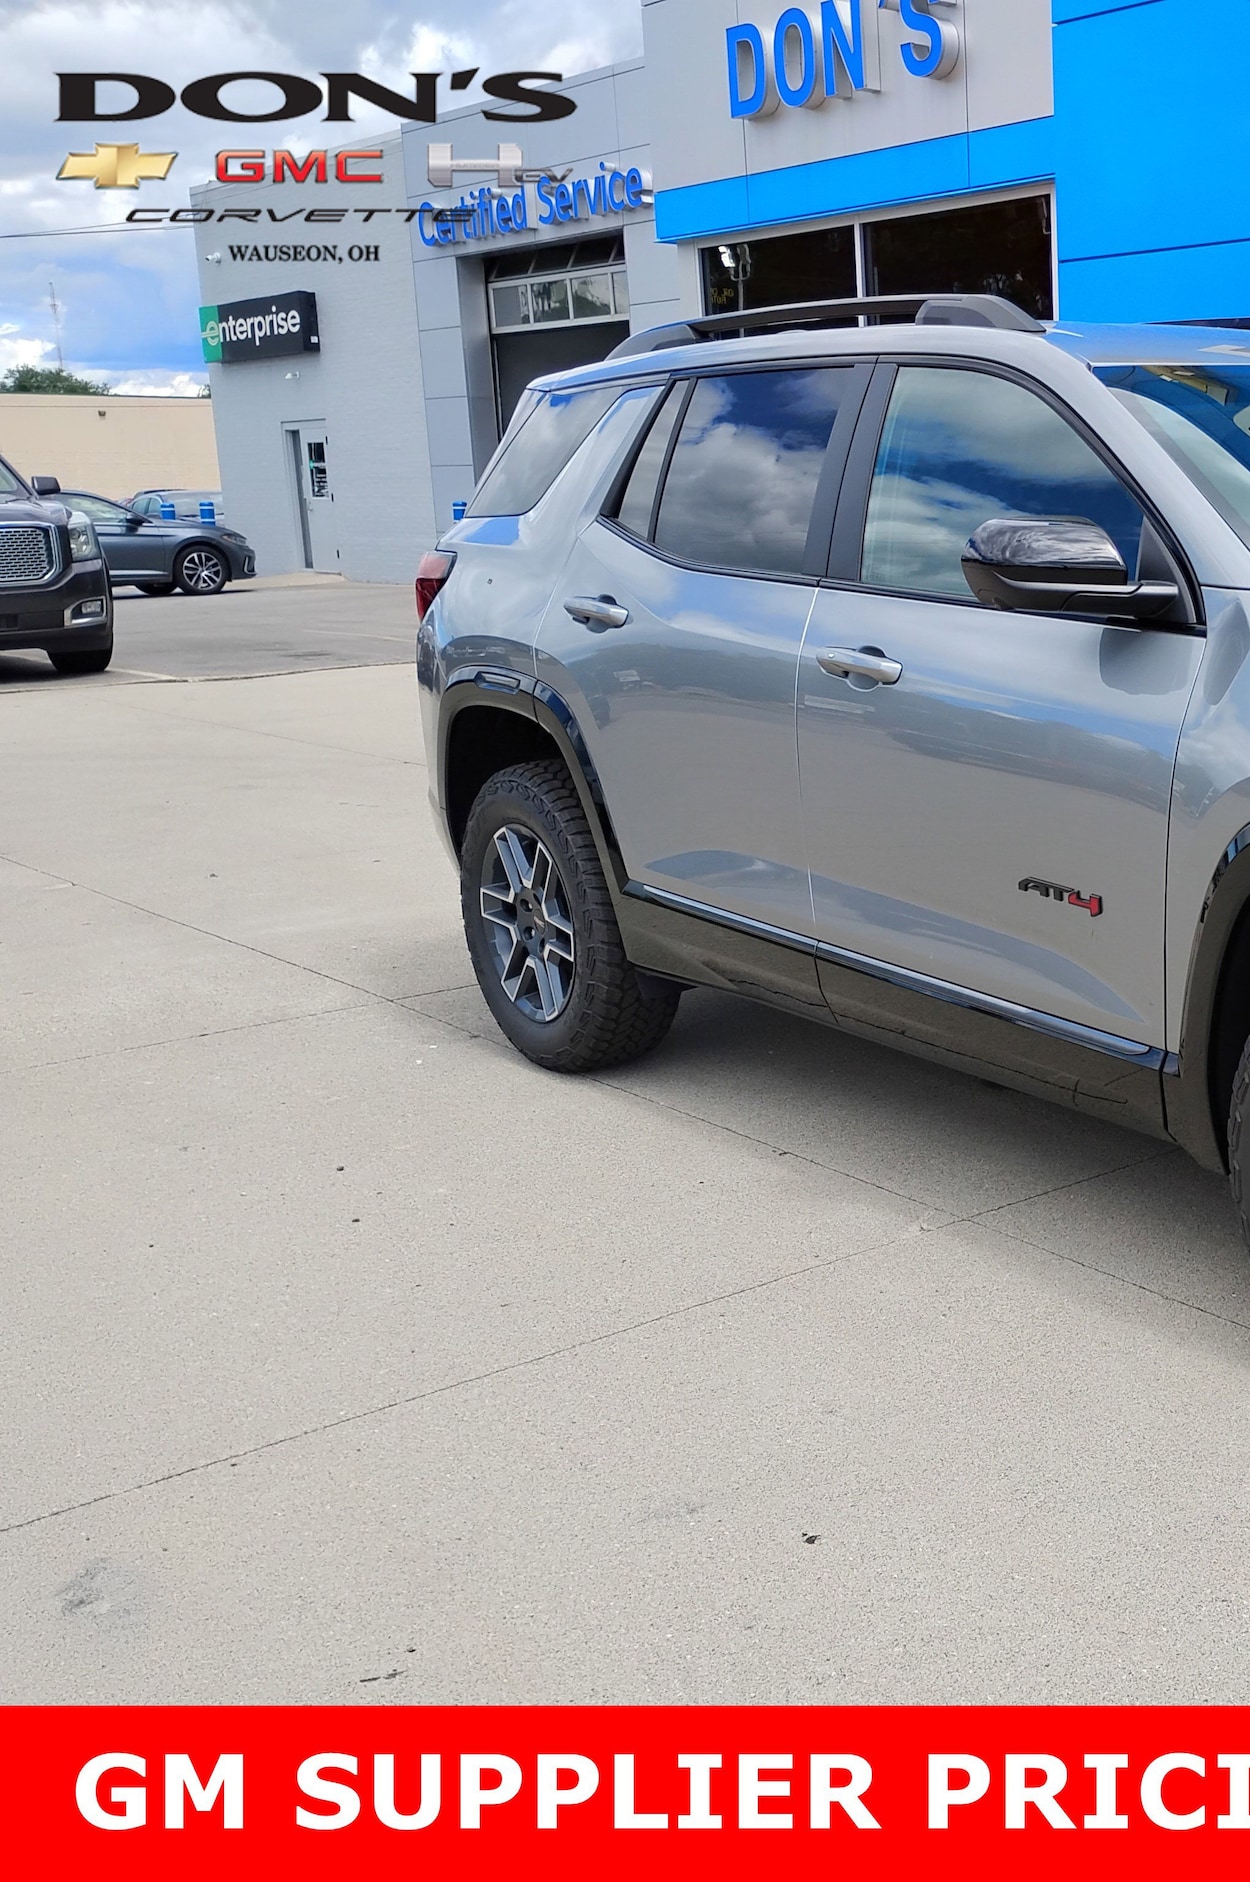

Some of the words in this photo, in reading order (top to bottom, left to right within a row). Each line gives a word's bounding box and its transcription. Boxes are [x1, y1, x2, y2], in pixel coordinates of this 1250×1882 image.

[726, 0, 943, 119] DONS
[418, 184, 530, 248] Certified
[536, 160, 645, 227] Service
[201, 305, 301, 347] enterprise
[1018, 876, 1103, 918] AT4
